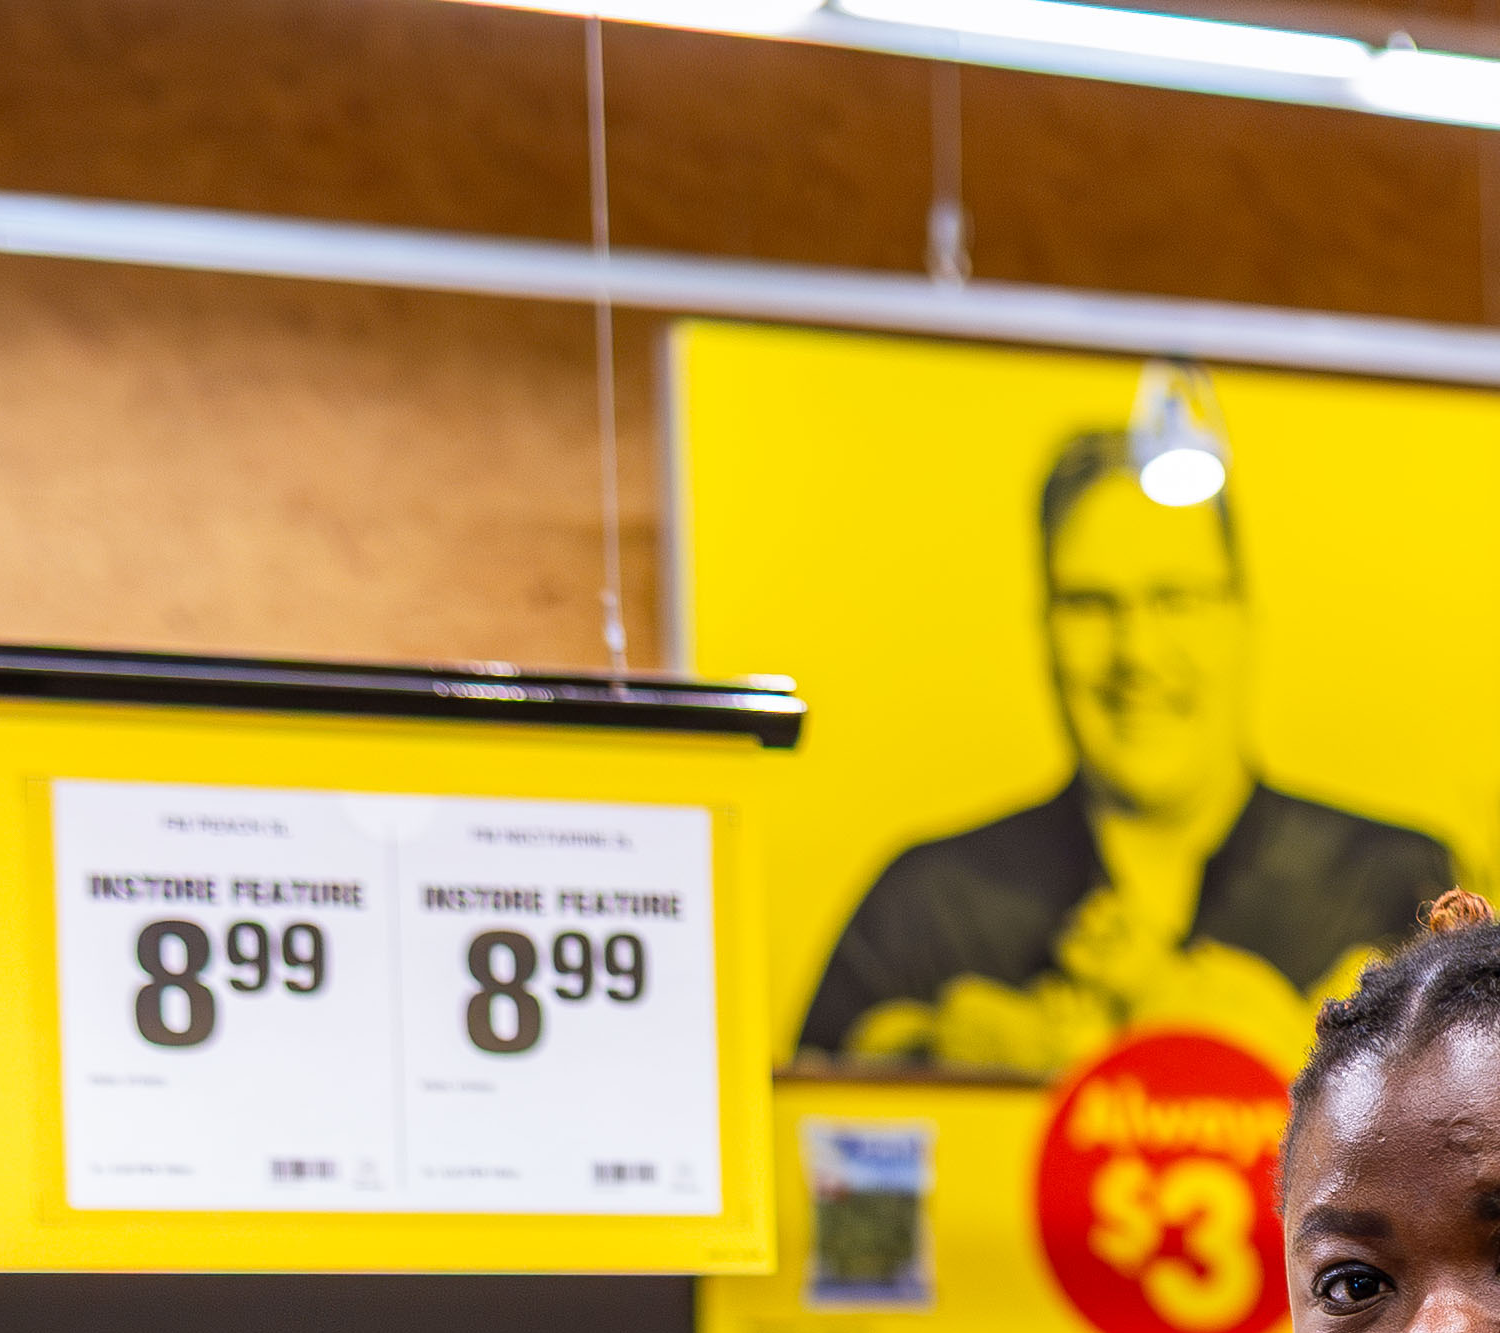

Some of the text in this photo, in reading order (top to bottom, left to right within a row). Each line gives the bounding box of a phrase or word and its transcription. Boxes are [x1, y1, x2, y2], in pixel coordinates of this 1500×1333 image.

[85, 874, 364, 909] INSTORE FEATURE
[421, 884, 684, 920] INSTORE FEATURE
